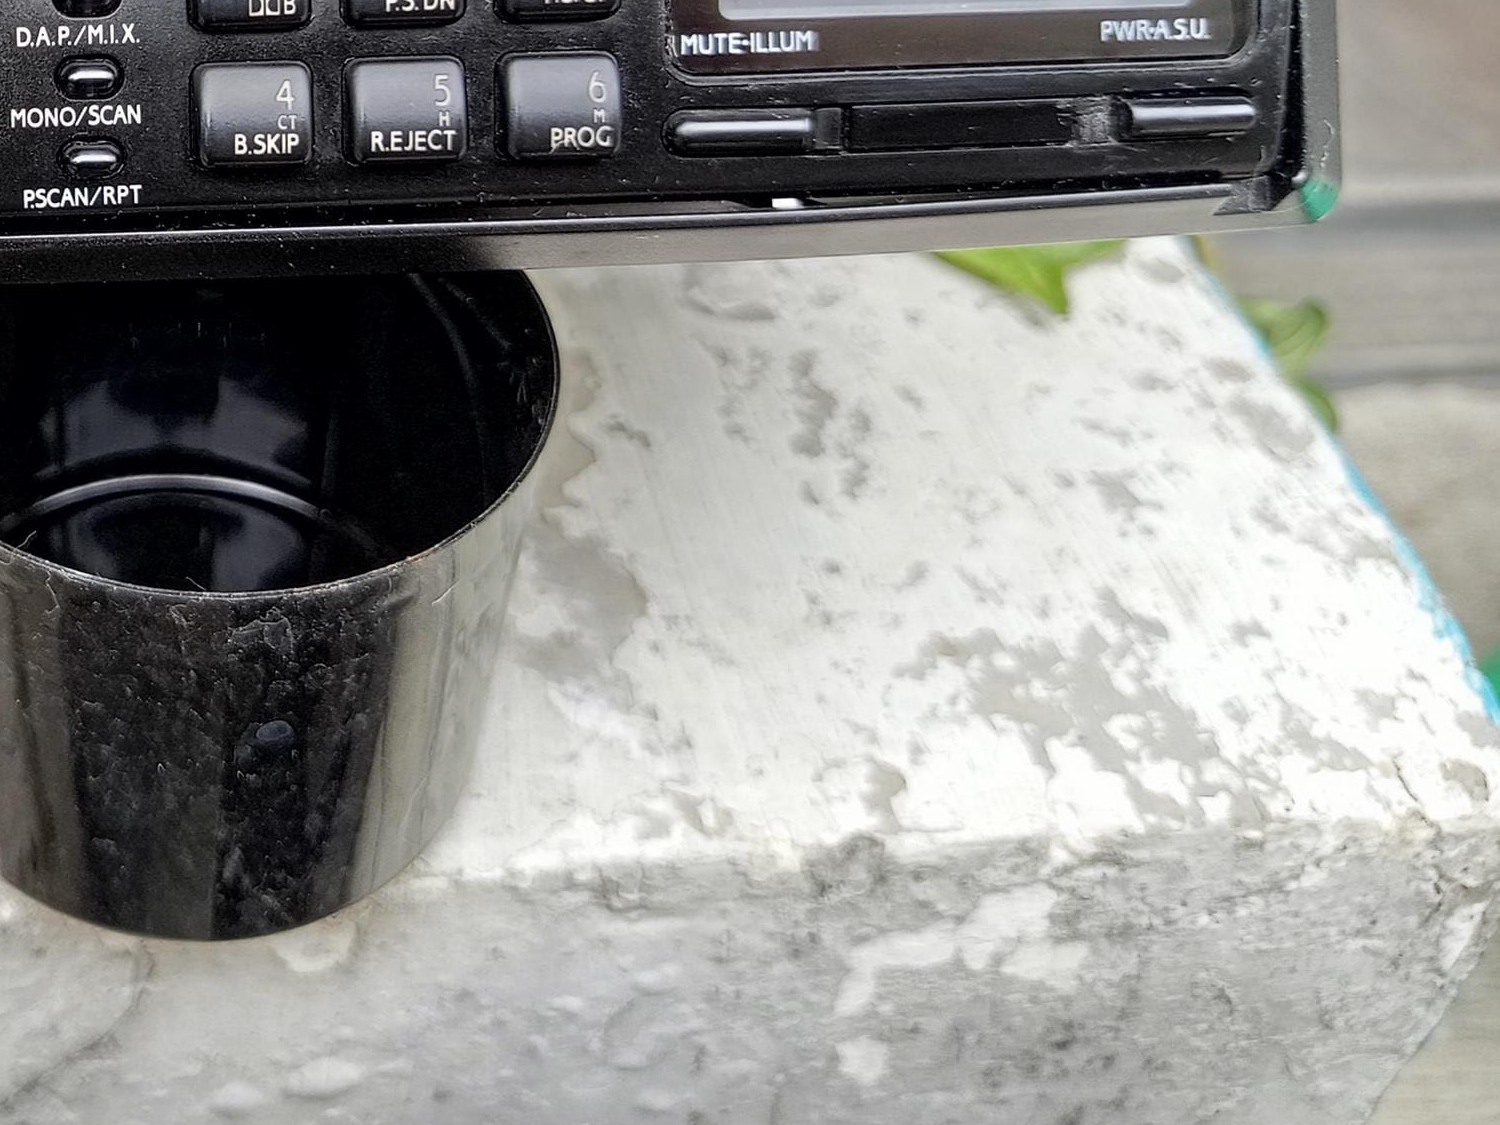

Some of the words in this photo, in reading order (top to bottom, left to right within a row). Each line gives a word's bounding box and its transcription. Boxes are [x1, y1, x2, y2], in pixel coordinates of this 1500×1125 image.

[276, 80, 295, 110] 4
[434, 75, 452, 107] 5
[589, 71, 606, 103] 6
[10, 105, 142, 128] MONO/SCAN
[278, 114, 296, 130] CT
[439, 111, 449, 126] H
[593, 108, 605, 123] M
[234, 133, 299, 156] B.SKIP
[550, 126, 614, 149] PROG
